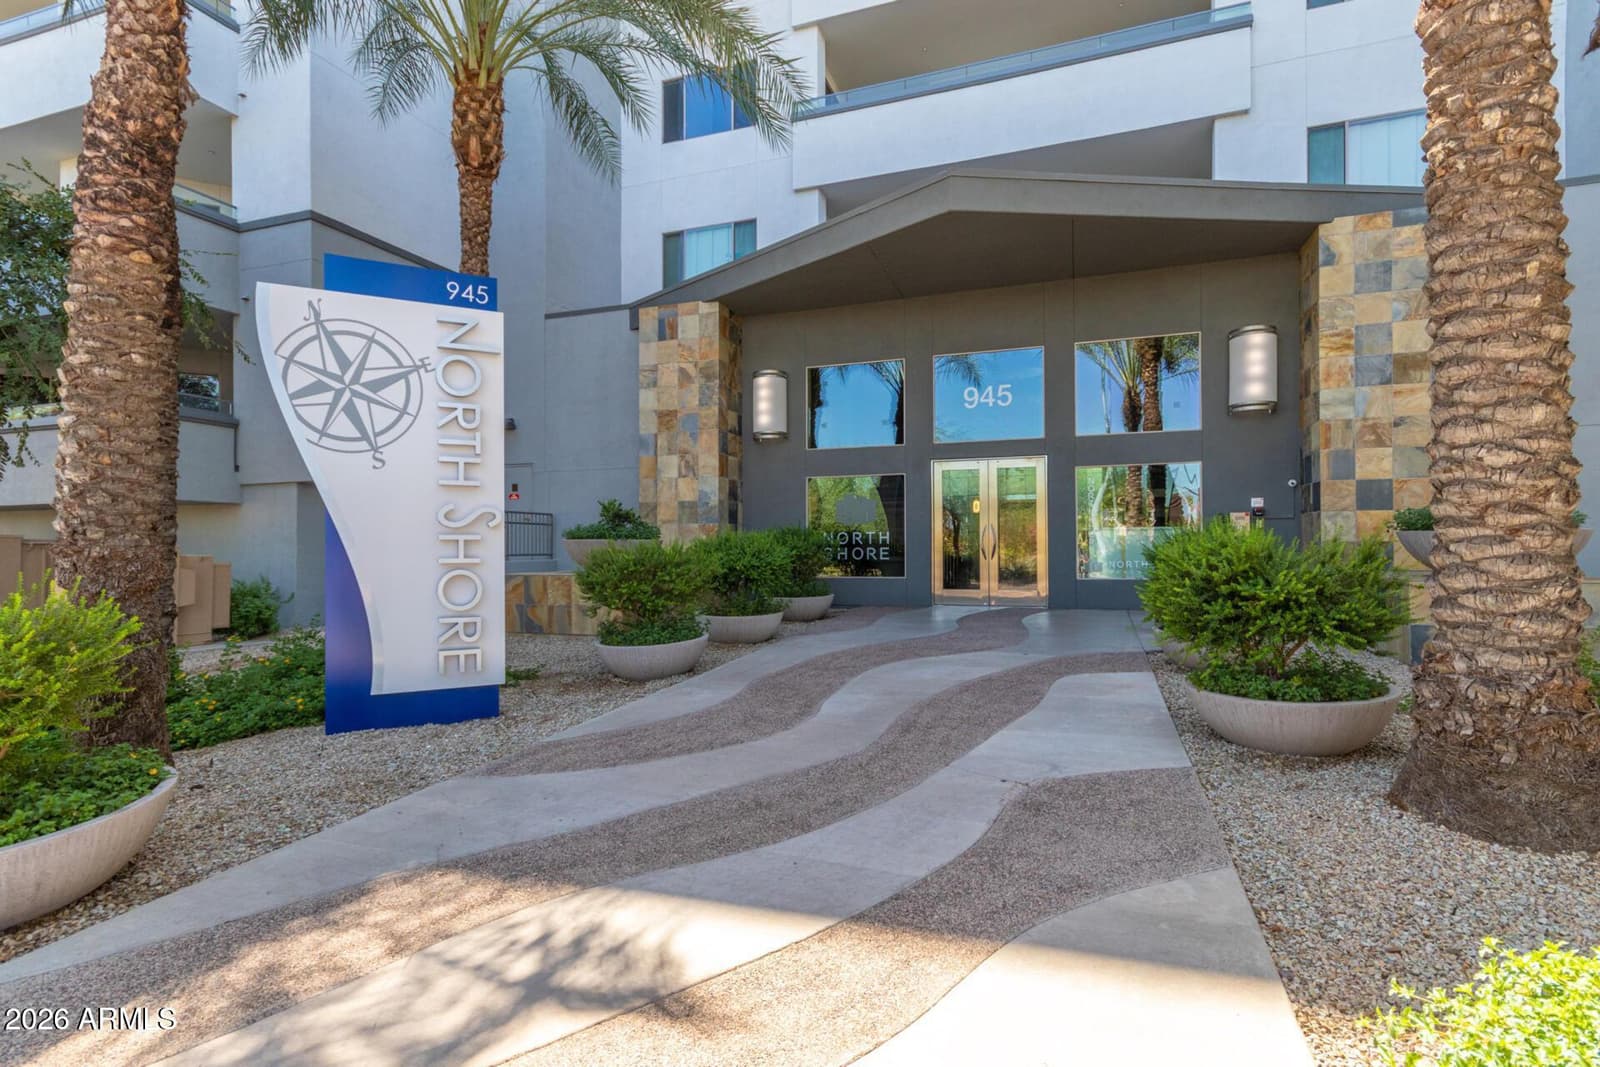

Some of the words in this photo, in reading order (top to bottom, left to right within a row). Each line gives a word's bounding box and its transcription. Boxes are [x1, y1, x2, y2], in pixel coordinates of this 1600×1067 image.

[446, 281, 489, 304] 945
[303, 298, 322, 323] N
[418, 356, 435, 373] E
[436, 315, 501, 487] NORTH
[963, 384, 1013, 408] 945
[371, 450, 386, 470] S
[436, 503, 501, 674] SHORE
